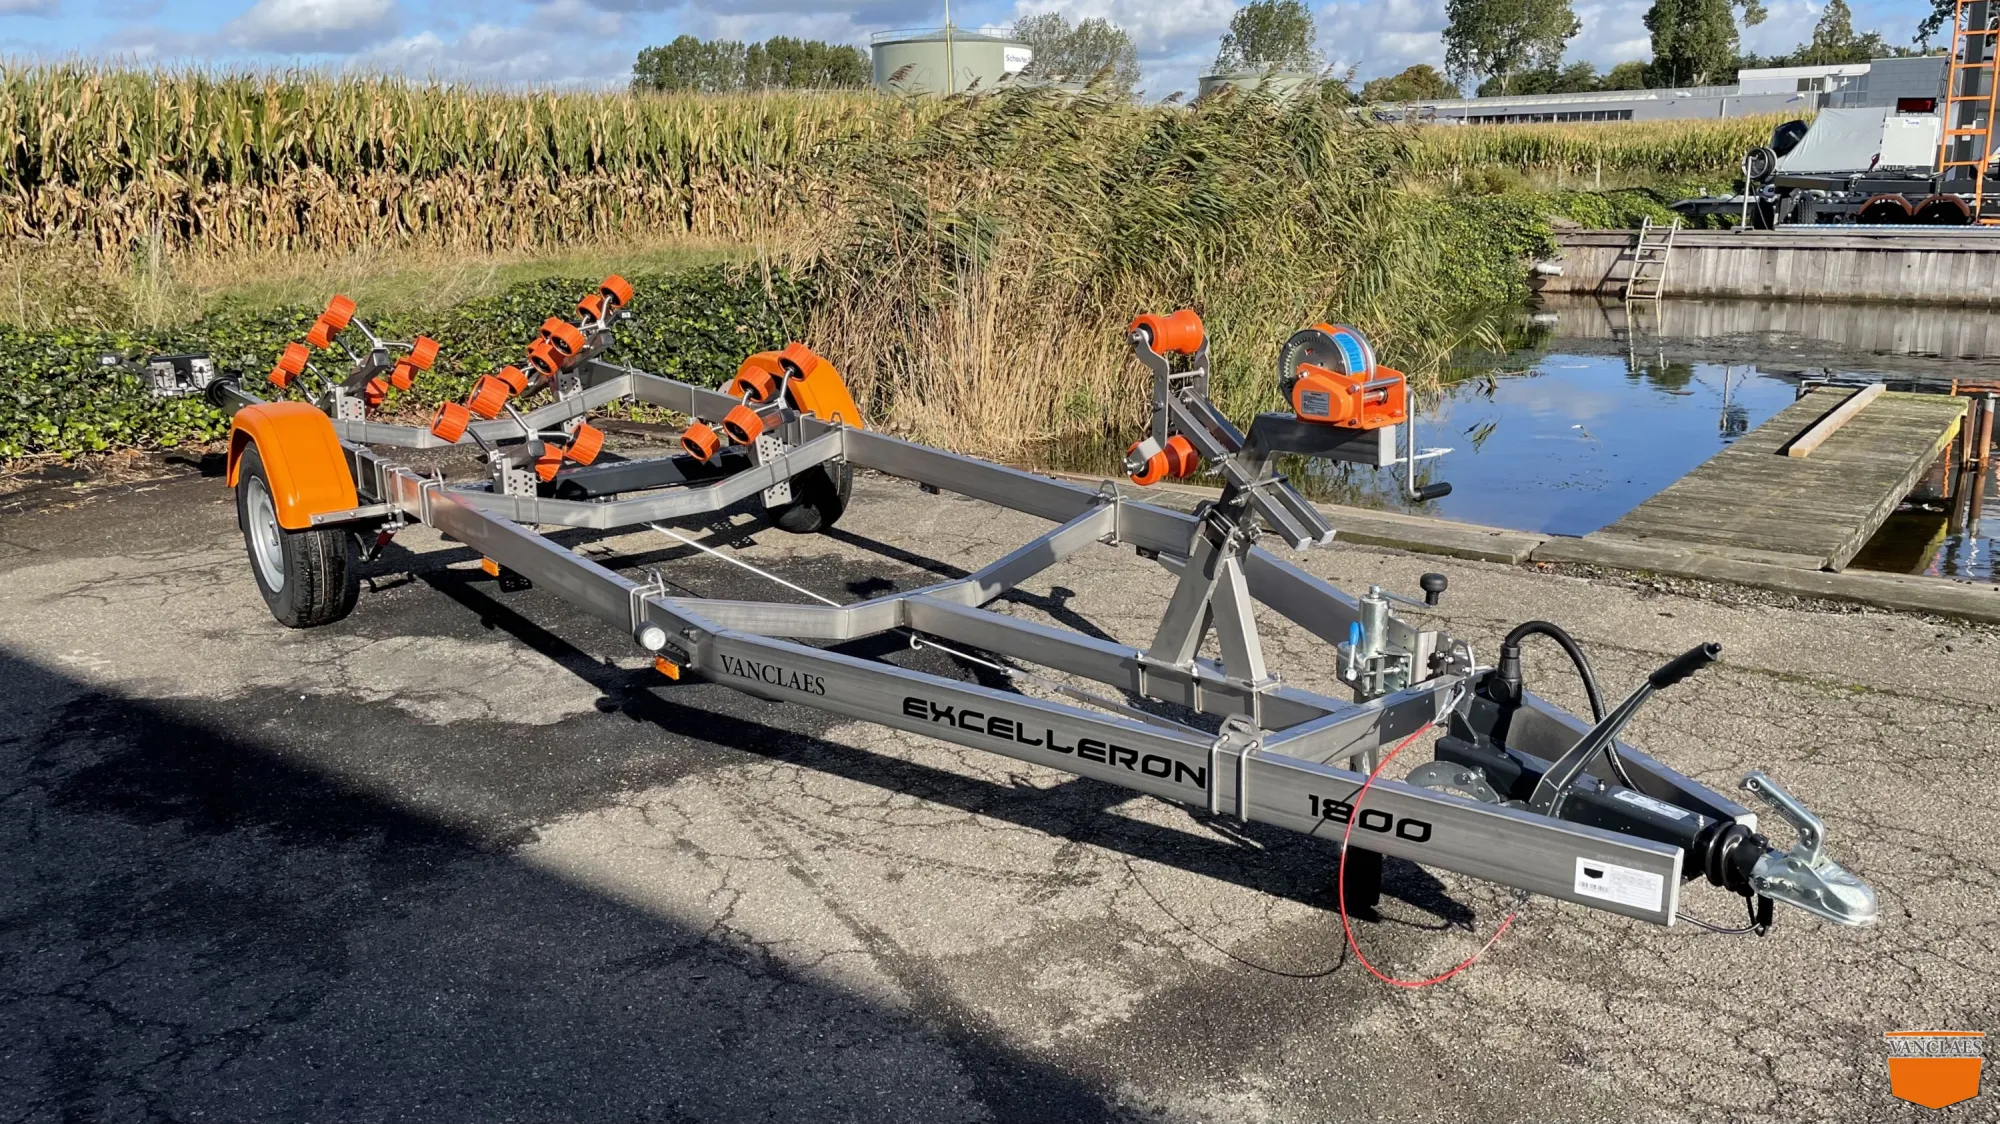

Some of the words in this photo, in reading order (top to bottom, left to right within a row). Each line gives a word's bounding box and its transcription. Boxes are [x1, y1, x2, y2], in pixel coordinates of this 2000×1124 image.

[720, 654, 826, 696] VANCLAES
[903, 696, 1206, 789] EXCELLERON
[1308, 794, 1432, 843] 1800
